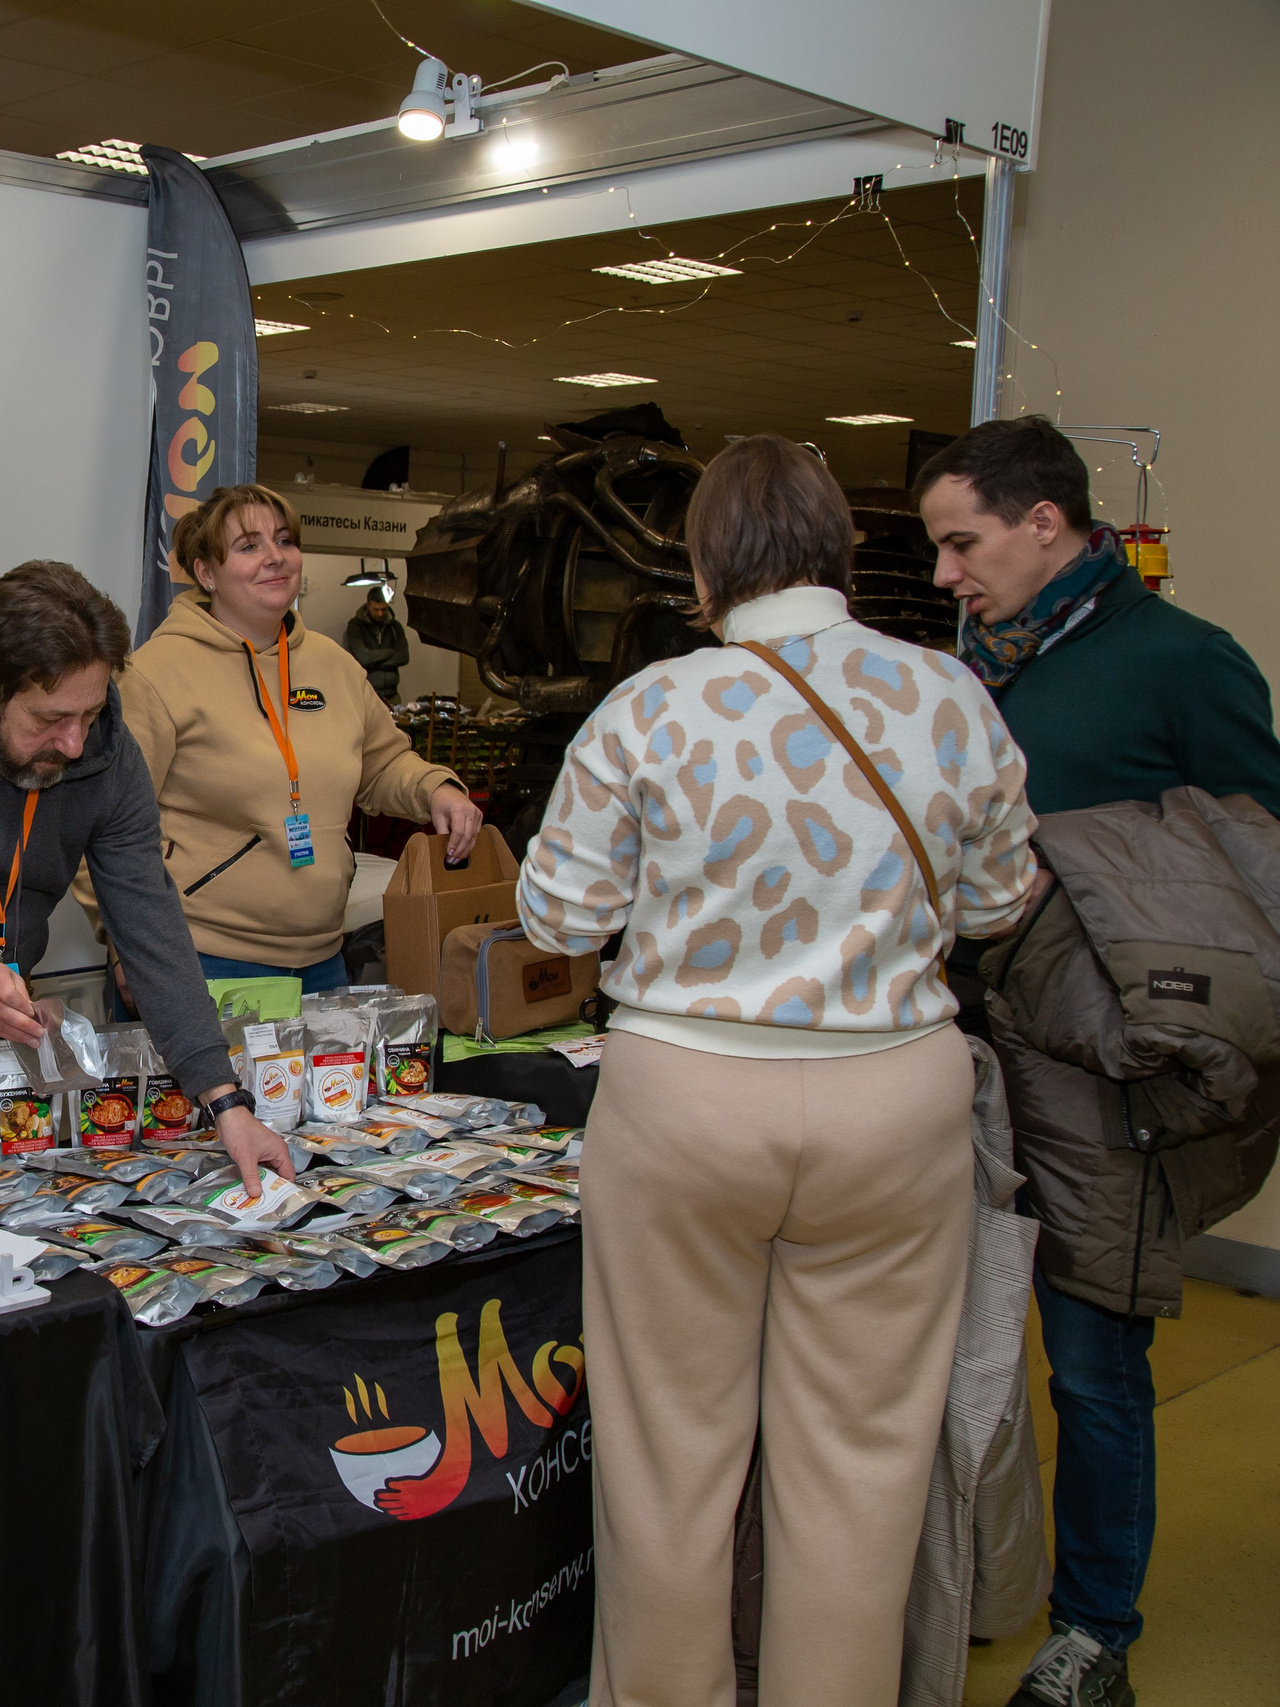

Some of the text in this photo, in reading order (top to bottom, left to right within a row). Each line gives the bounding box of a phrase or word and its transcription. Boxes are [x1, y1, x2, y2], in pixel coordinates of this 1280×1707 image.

[991, 121, 1028, 159] 1E09
[363, 516, 407, 533] Казани
[295, 690, 318, 701] Мои
[434, 1298, 588, 1460] Мо
